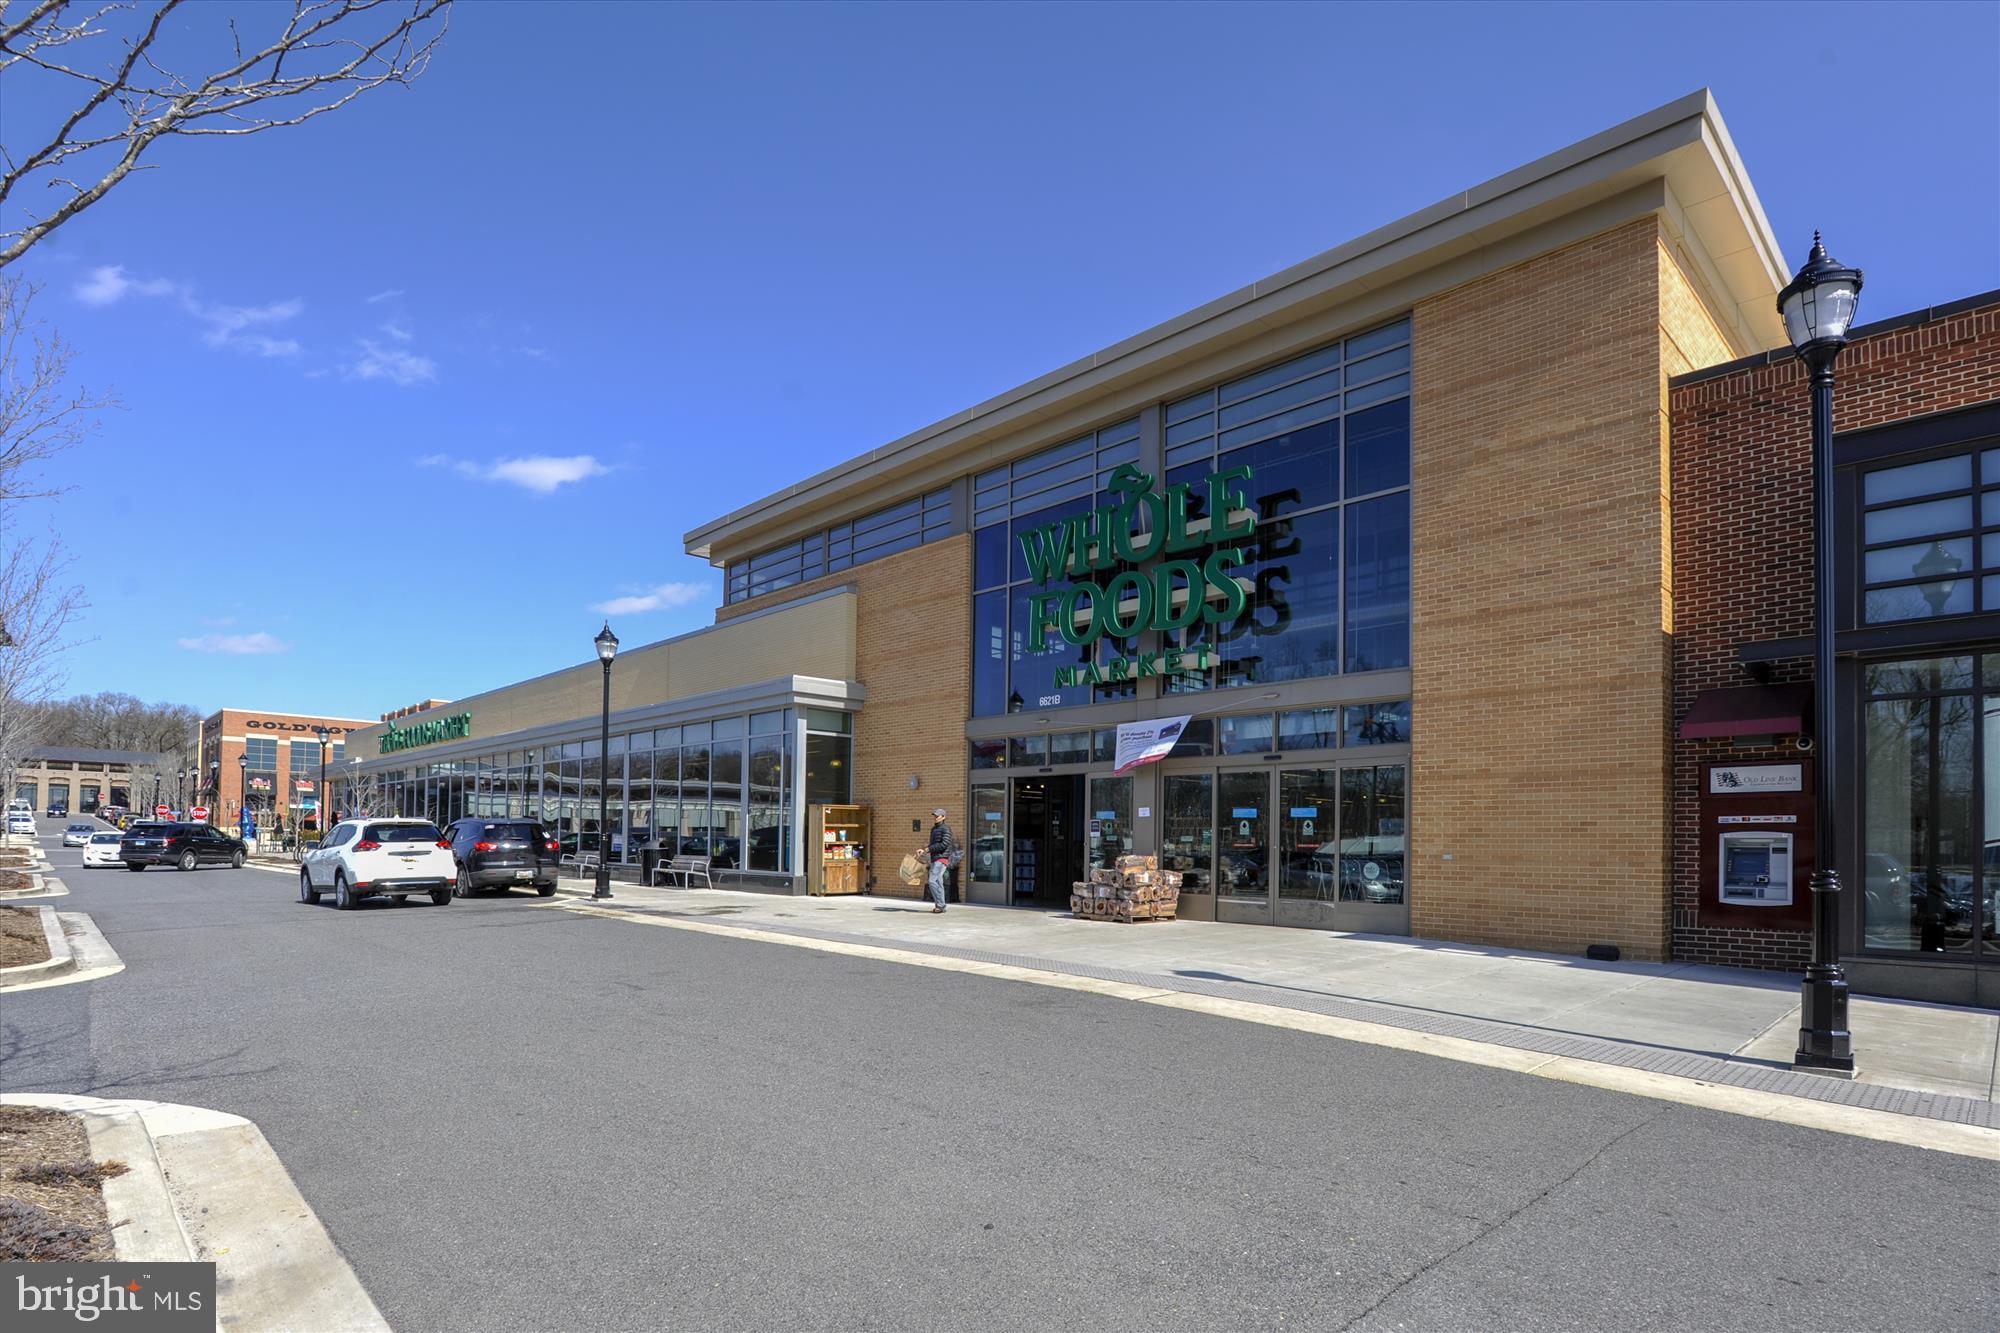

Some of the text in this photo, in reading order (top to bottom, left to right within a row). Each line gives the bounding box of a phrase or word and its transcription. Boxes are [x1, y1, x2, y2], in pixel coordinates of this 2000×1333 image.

[1017, 463, 1254, 586] WHOLE
[1026, 547, 1247, 653] FOODS
[1054, 643, 1214, 689] MARKET
[1039, 694, 1061, 706] 6621B
[246, 720, 322, 734] GOLD'S
